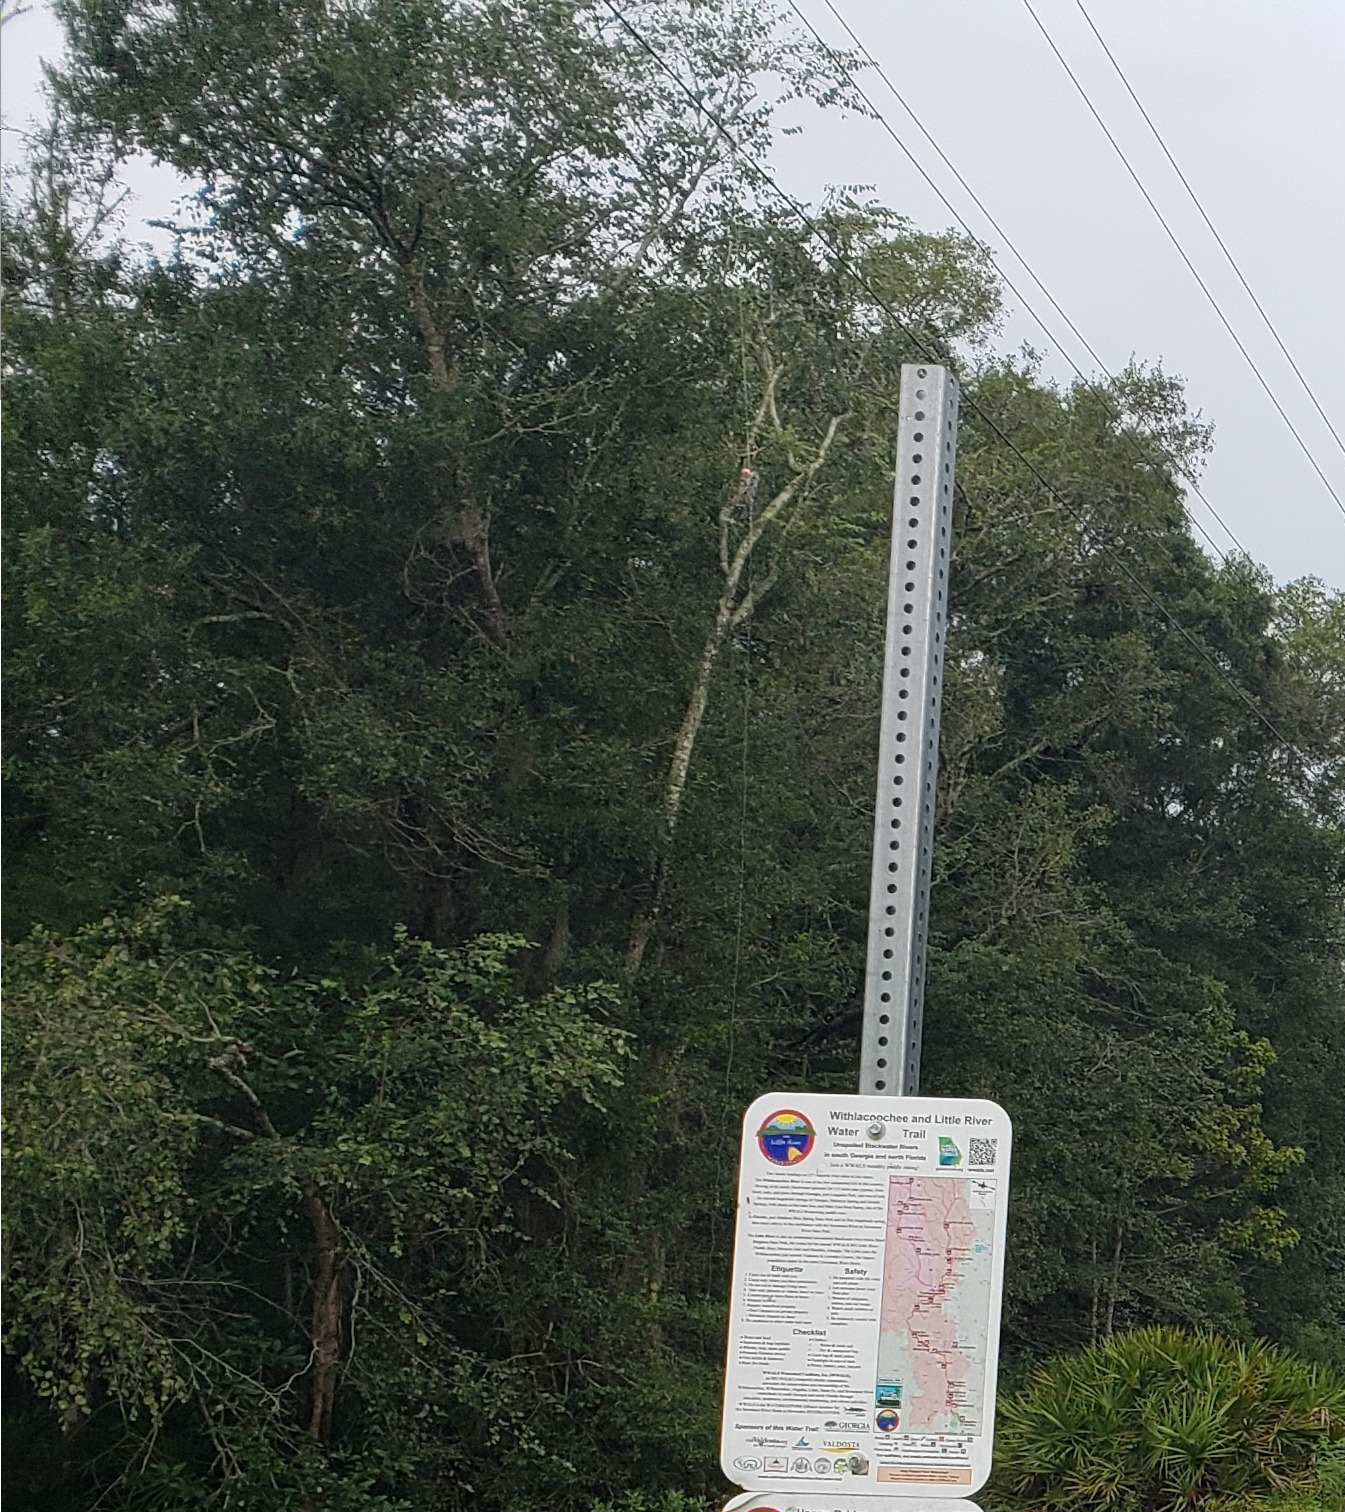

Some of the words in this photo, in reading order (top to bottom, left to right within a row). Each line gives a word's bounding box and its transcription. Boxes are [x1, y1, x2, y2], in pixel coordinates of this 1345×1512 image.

[829, 1111, 908, 1123] Withlacoochee
[911, 1114, 931, 1124] and
[935, 1115, 960, 1124] Little
[964, 1116, 992, 1126] River
[827, 1126, 860, 1136] Water
[902, 1129, 926, 1138] Trail
[865, 1142, 898, 1150] Blackwater
[850, 1152, 874, 1160] Georgia
[771, 1265, 804, 1273] Etiquette
[844, 1268, 868, 1276] Safety
[792, 1328, 826, 1336] Checklist
[734, 1423, 764, 1431] Sponsors
[838, 1422, 870, 1430] GEORGIA
[823, 1440, 860, 1448] VALDOSTA
